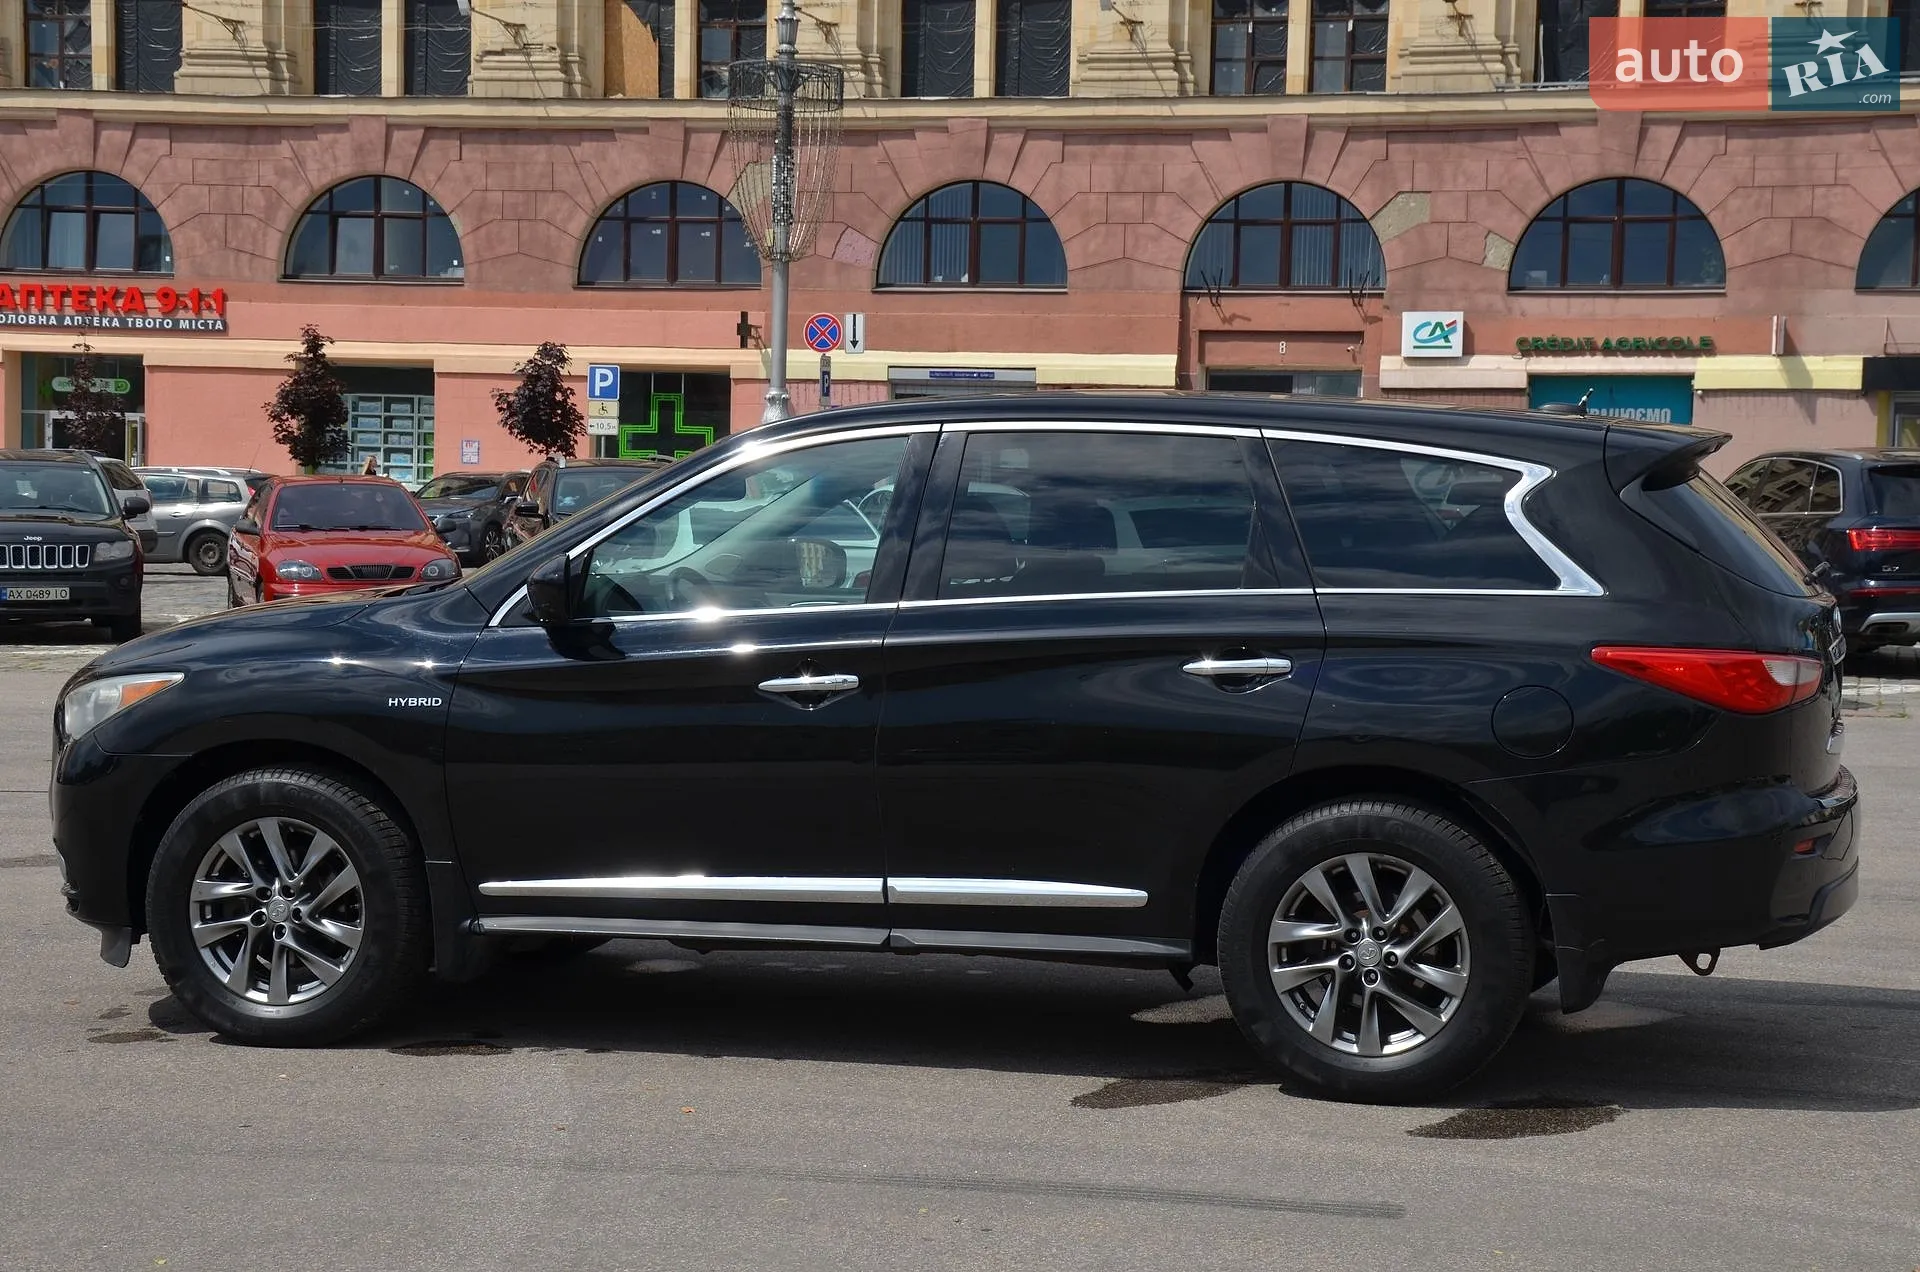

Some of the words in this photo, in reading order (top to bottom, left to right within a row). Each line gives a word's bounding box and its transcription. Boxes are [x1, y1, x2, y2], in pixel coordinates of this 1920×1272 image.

[0, 284, 146, 313] АПТЕКА
[63, 316, 120, 328] АПТЕКА
[126, 318, 173, 329] ТВОГО
[179, 319, 224, 330] МІСТА
[1279, 341, 1286, 354] 8
[1601, 336, 1713, 350] AGRICOLE
[594, 368, 614, 396] P
[8, 590, 23, 599] AX
[26, 589, 51, 599] 0489
[388, 697, 442, 707] HYBRID
